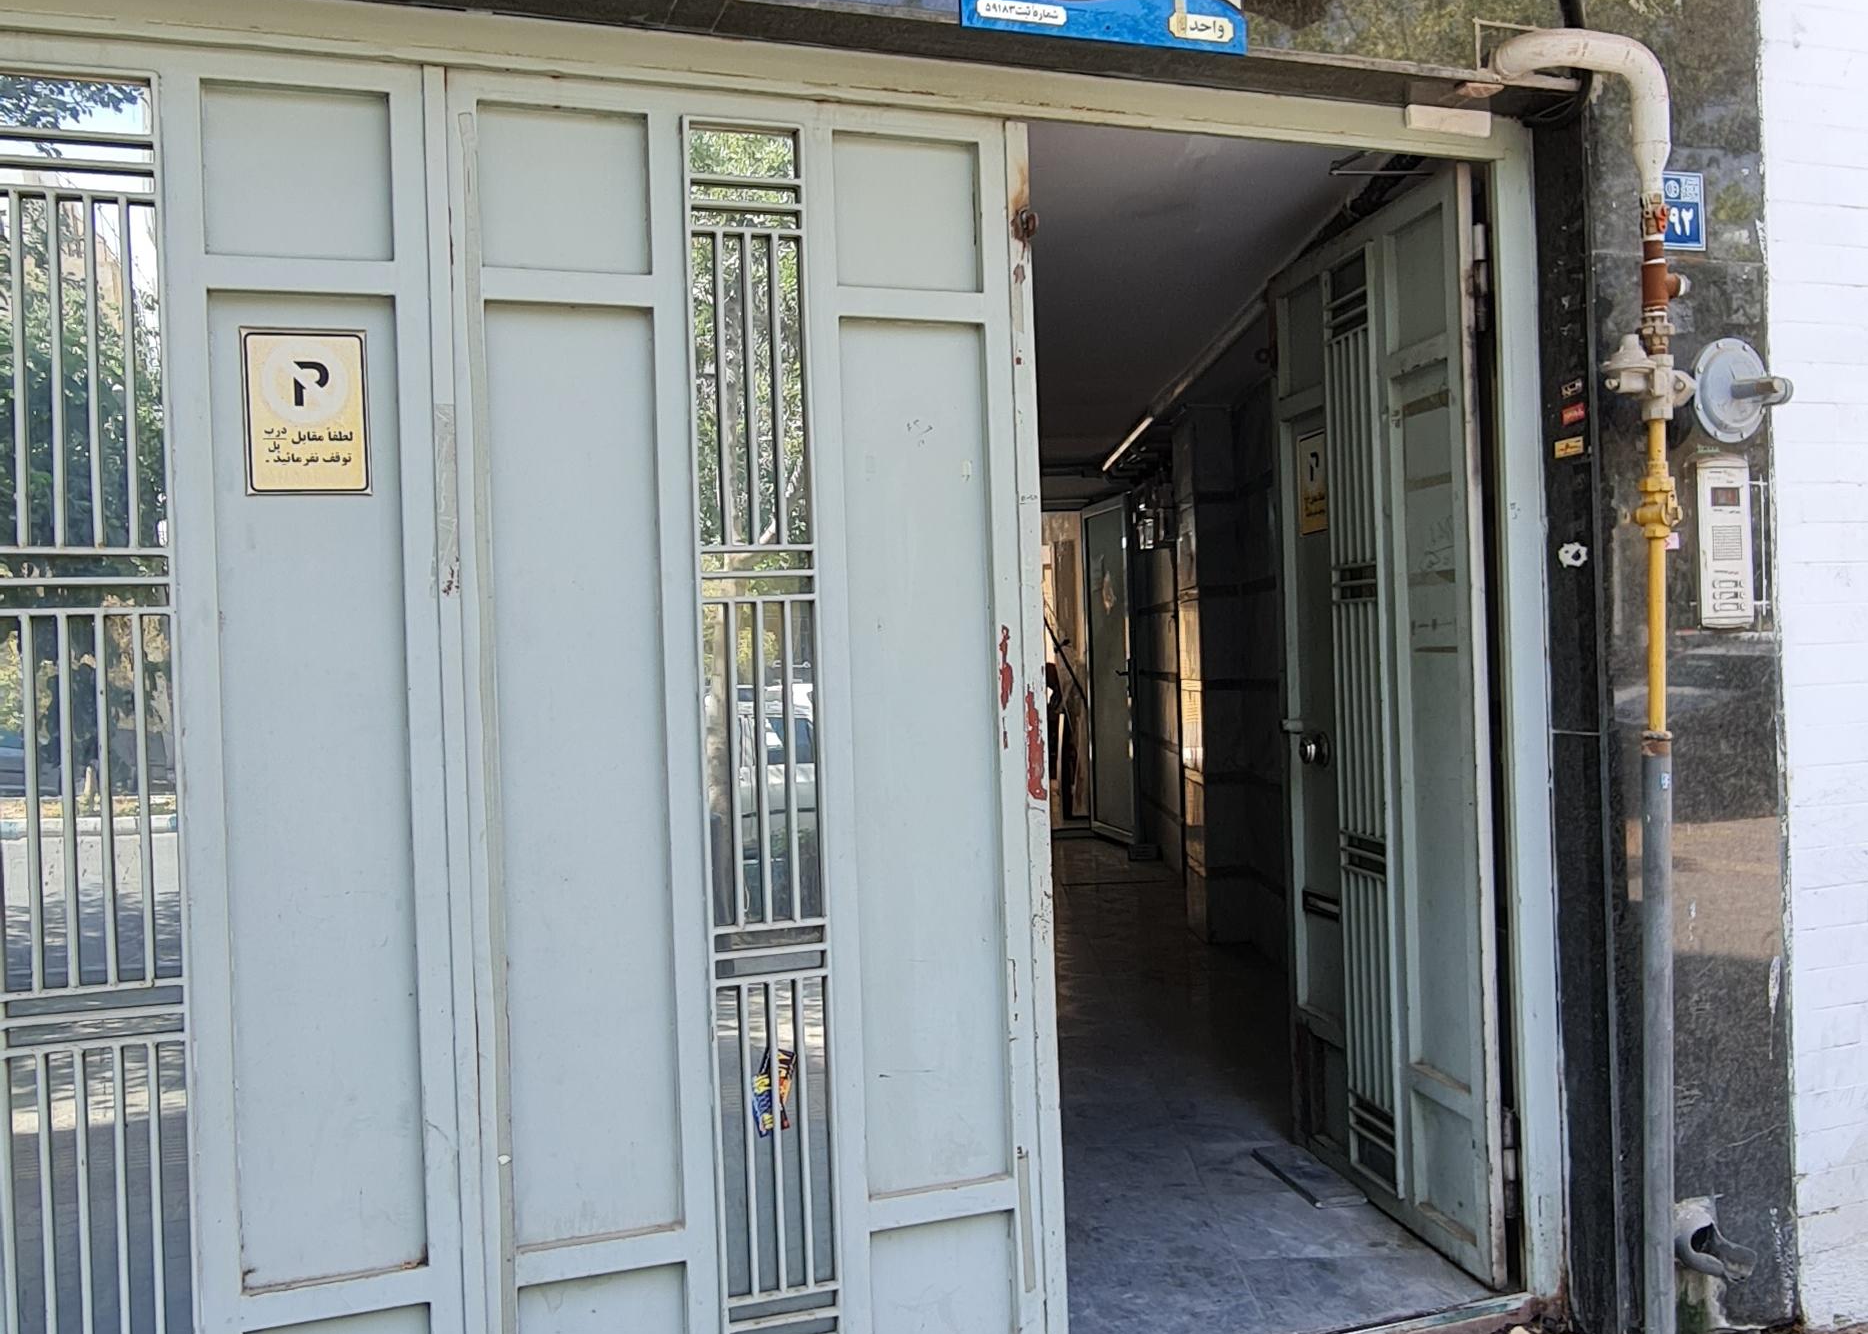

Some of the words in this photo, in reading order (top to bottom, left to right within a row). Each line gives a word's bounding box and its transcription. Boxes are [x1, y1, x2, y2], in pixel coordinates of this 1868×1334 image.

[1189, 20, 1225, 39] واحد
[263, 426, 288, 438] درب
[291, 430, 324, 445] مقابل
[322, 451, 353, 466] توقف
